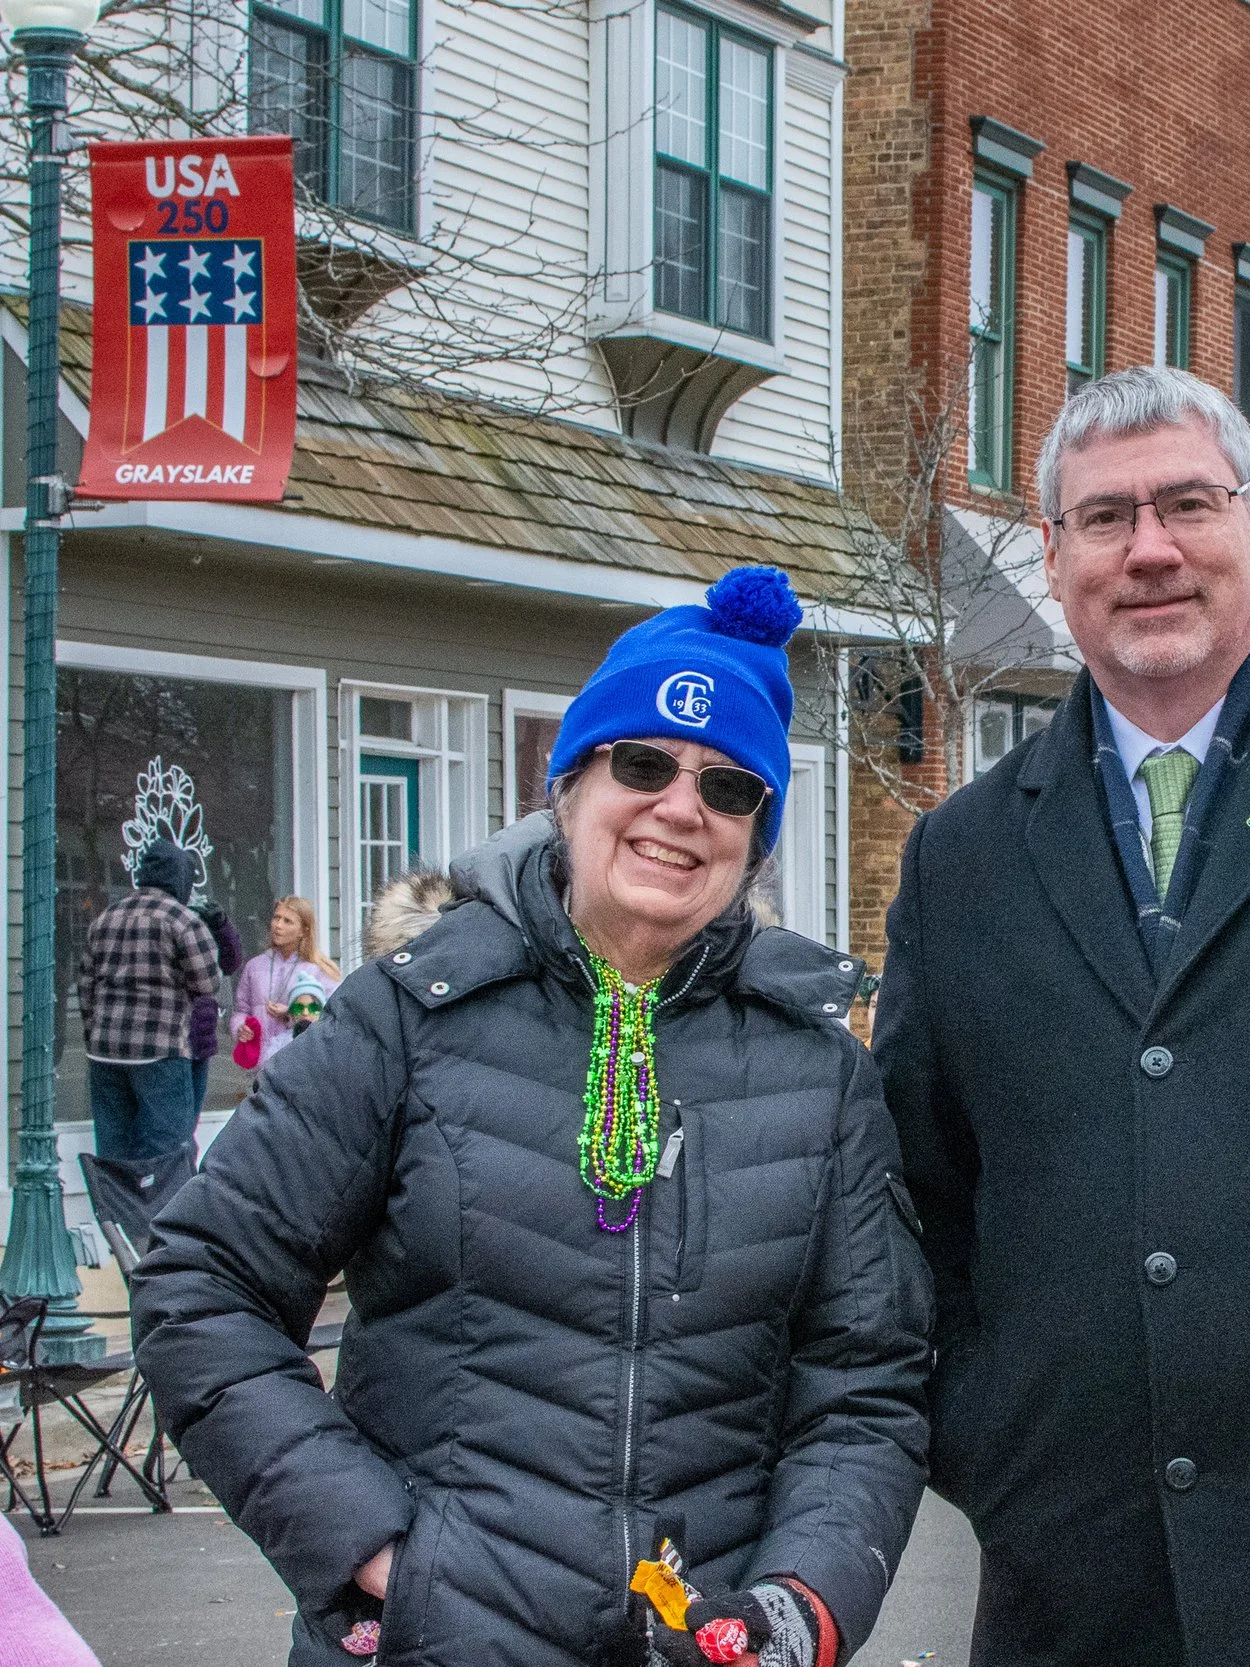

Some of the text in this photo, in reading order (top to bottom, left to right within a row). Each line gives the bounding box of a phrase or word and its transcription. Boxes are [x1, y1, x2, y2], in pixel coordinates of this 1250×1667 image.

[145, 154, 240, 198] USA
[157, 200, 229, 234] 250
[115, 464, 255, 484] GRAYSLAKE
